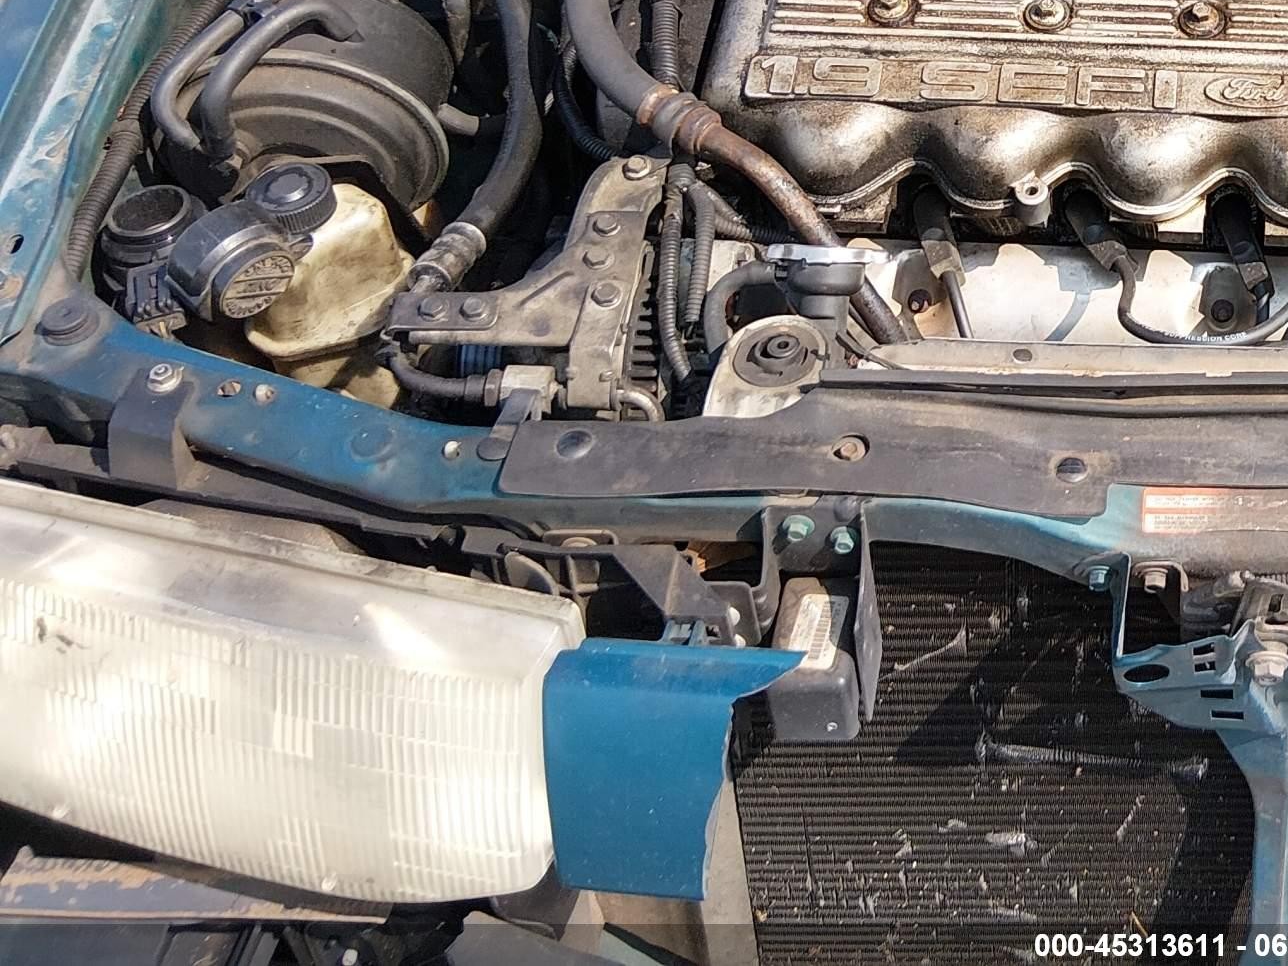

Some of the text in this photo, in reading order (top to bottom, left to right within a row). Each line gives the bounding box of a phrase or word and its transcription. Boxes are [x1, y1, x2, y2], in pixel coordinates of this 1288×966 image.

[760, 55, 1286, 110] 1.9 SEFI Ford
